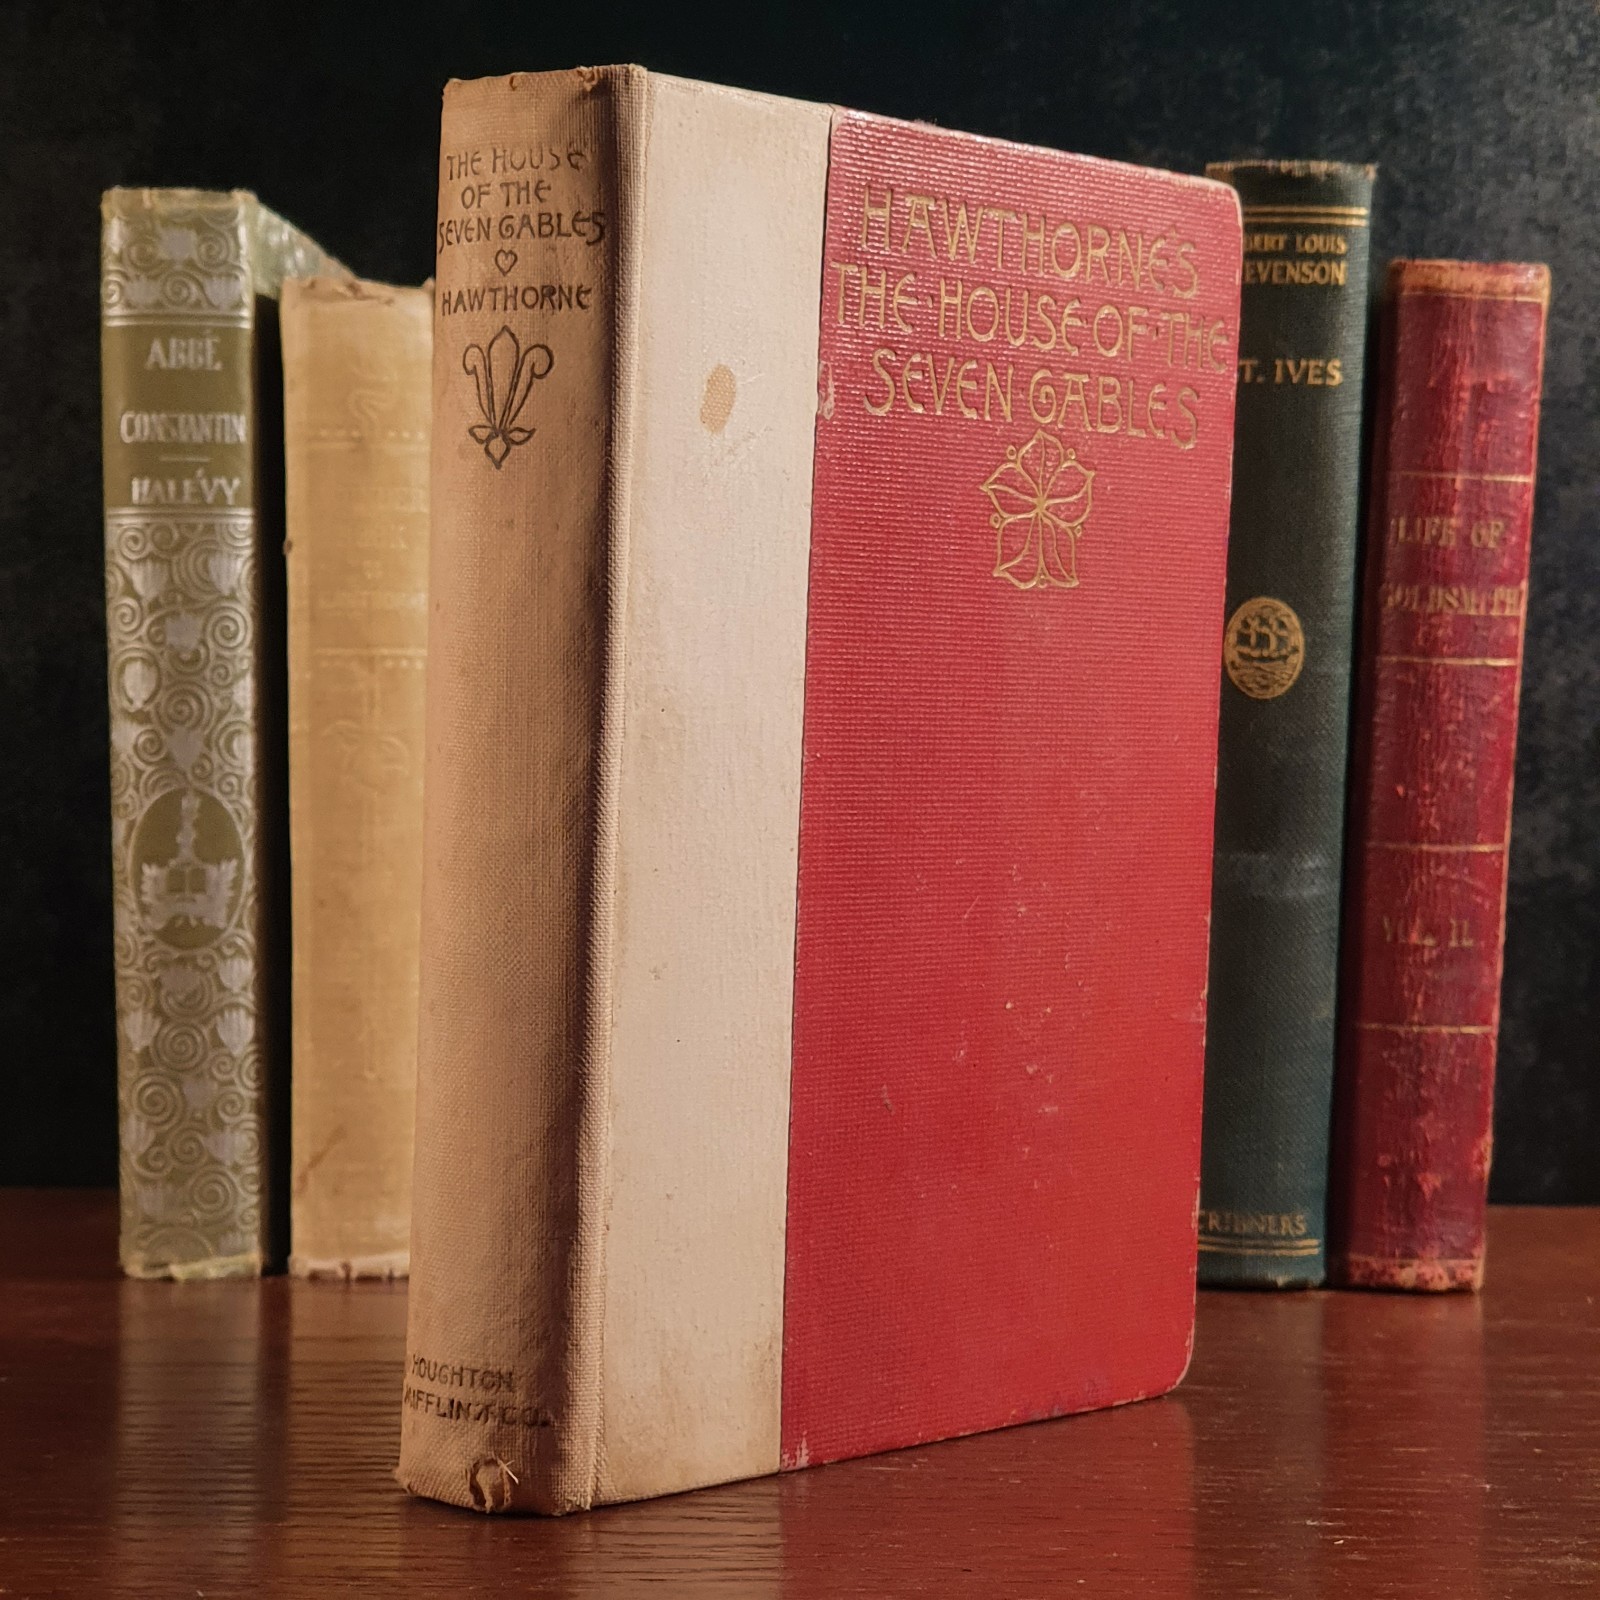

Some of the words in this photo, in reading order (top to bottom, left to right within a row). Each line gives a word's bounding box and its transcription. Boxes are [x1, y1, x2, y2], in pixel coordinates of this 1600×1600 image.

[447, 151, 482, 181] THE
[492, 146, 587, 174] HOUSE
[461, 184, 491, 210] OF
[500, 179, 551, 207] THE
[438, 217, 491, 254] SEVEN
[498, 210, 605, 246] GABLES
[1296, 233, 1347, 255] LOUIS
[442, 284, 592, 316] HAWTHORNE
[831, 260, 919, 334] THE
[938, 276, 1083, 356] HOUSE
[1092, 304, 1150, 363] OF
[1160, 311, 1230, 374] THE
[1275, 358, 1343, 386] IVES
[864, 348, 1014, 424] SEVEN
[1029, 368, 1200, 450] GABLES
